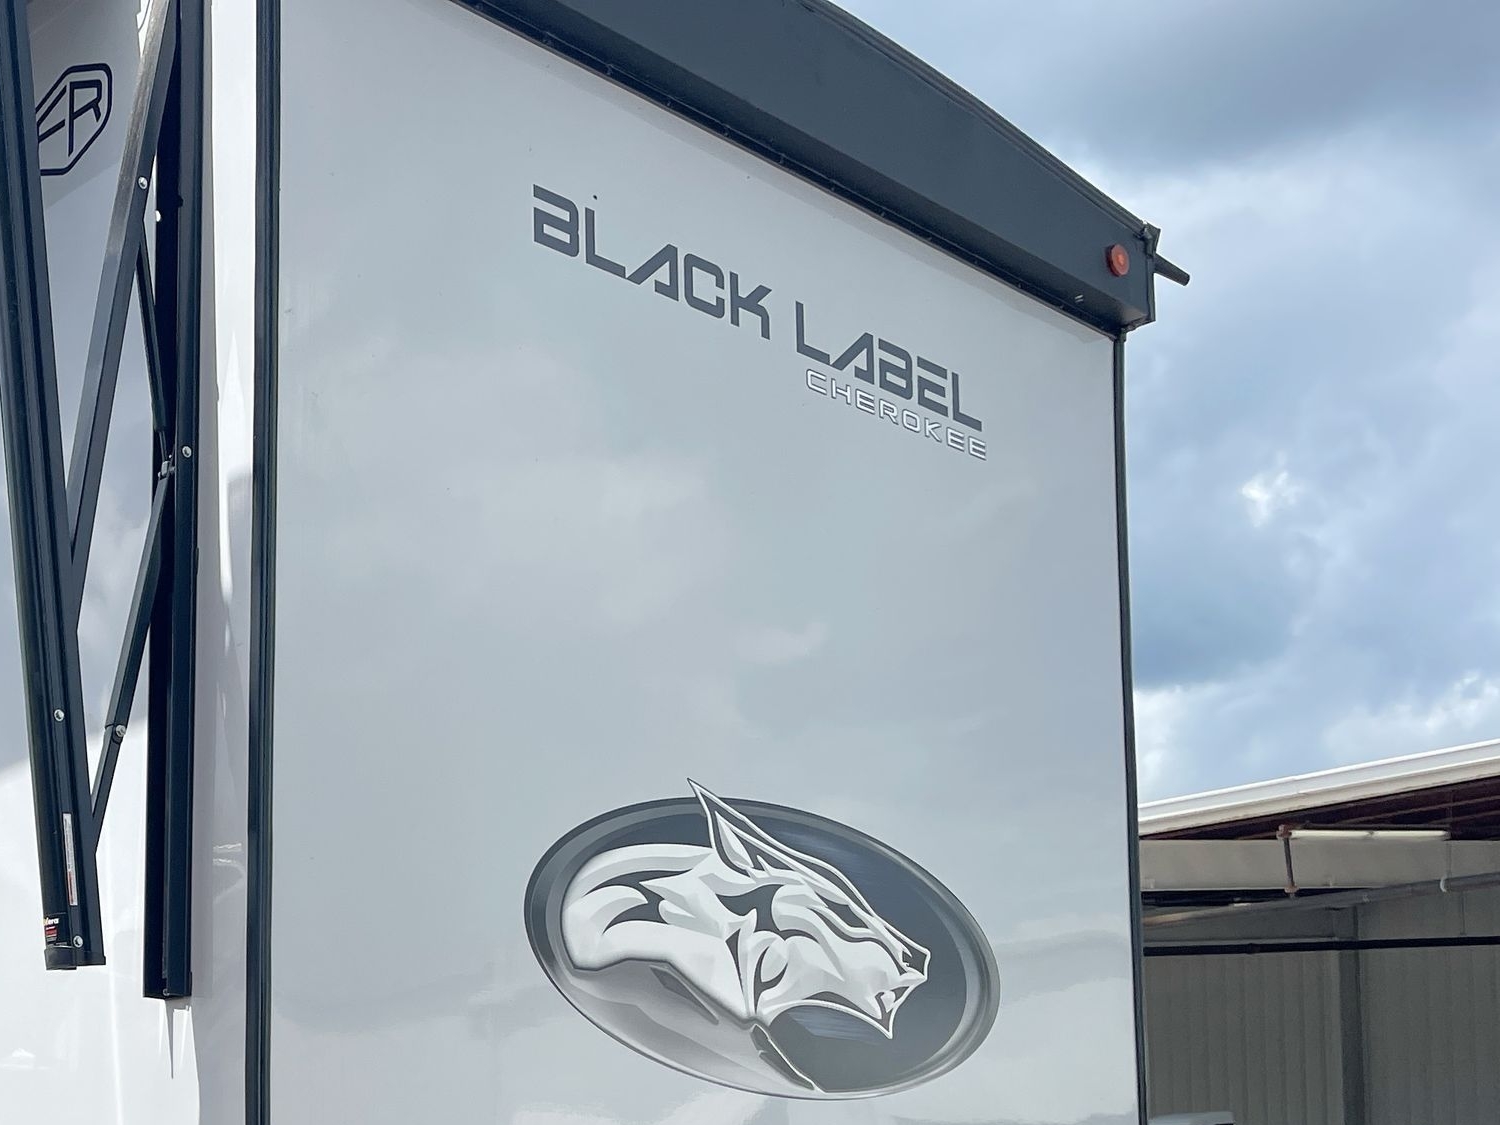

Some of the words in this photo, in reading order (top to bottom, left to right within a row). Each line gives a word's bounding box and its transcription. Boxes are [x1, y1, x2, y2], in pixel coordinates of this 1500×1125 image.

[532, 183, 773, 341] BLACK
[794, 300, 983, 432] LABEL
[805, 367, 988, 461] CHEROKEE
